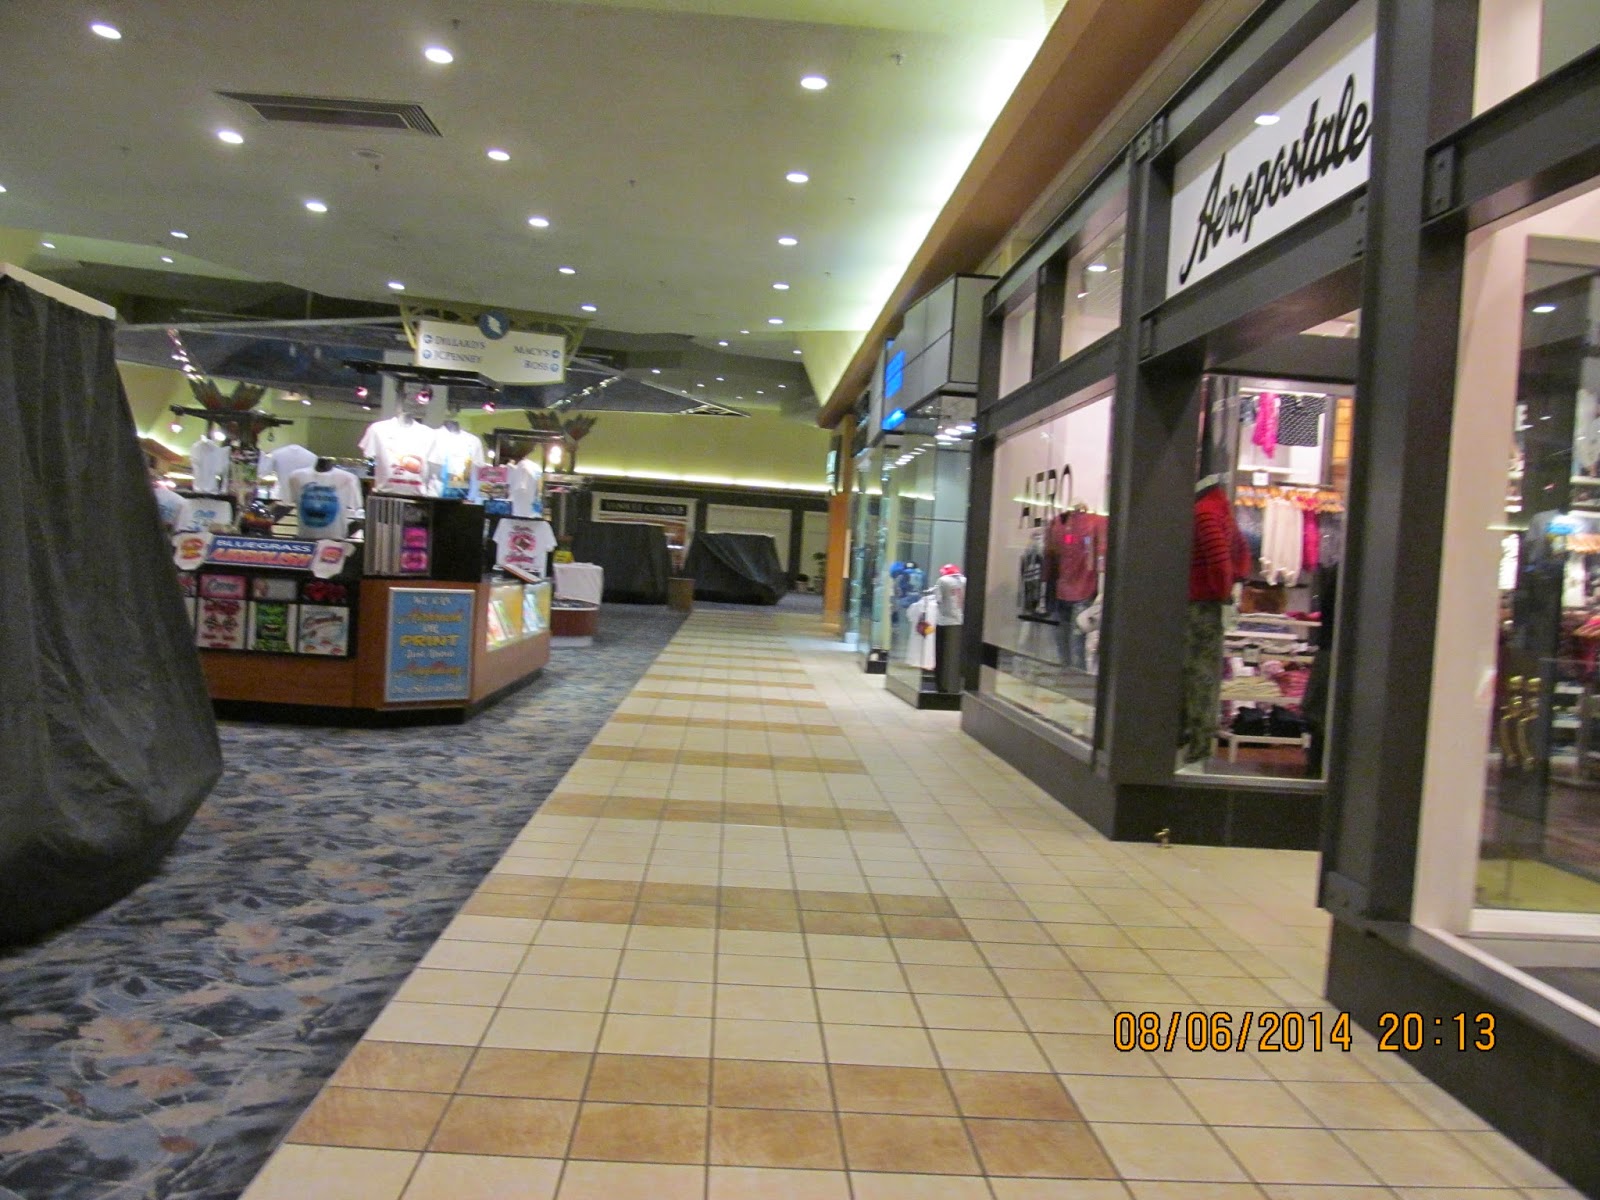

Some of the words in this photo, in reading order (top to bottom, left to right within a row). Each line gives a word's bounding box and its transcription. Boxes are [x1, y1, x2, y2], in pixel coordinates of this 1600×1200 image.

[1179, 73, 1373, 285] Aeropostale
[524, 359, 549, 371] ROSS
[216, 539, 312, 553] BLUEGRASS
